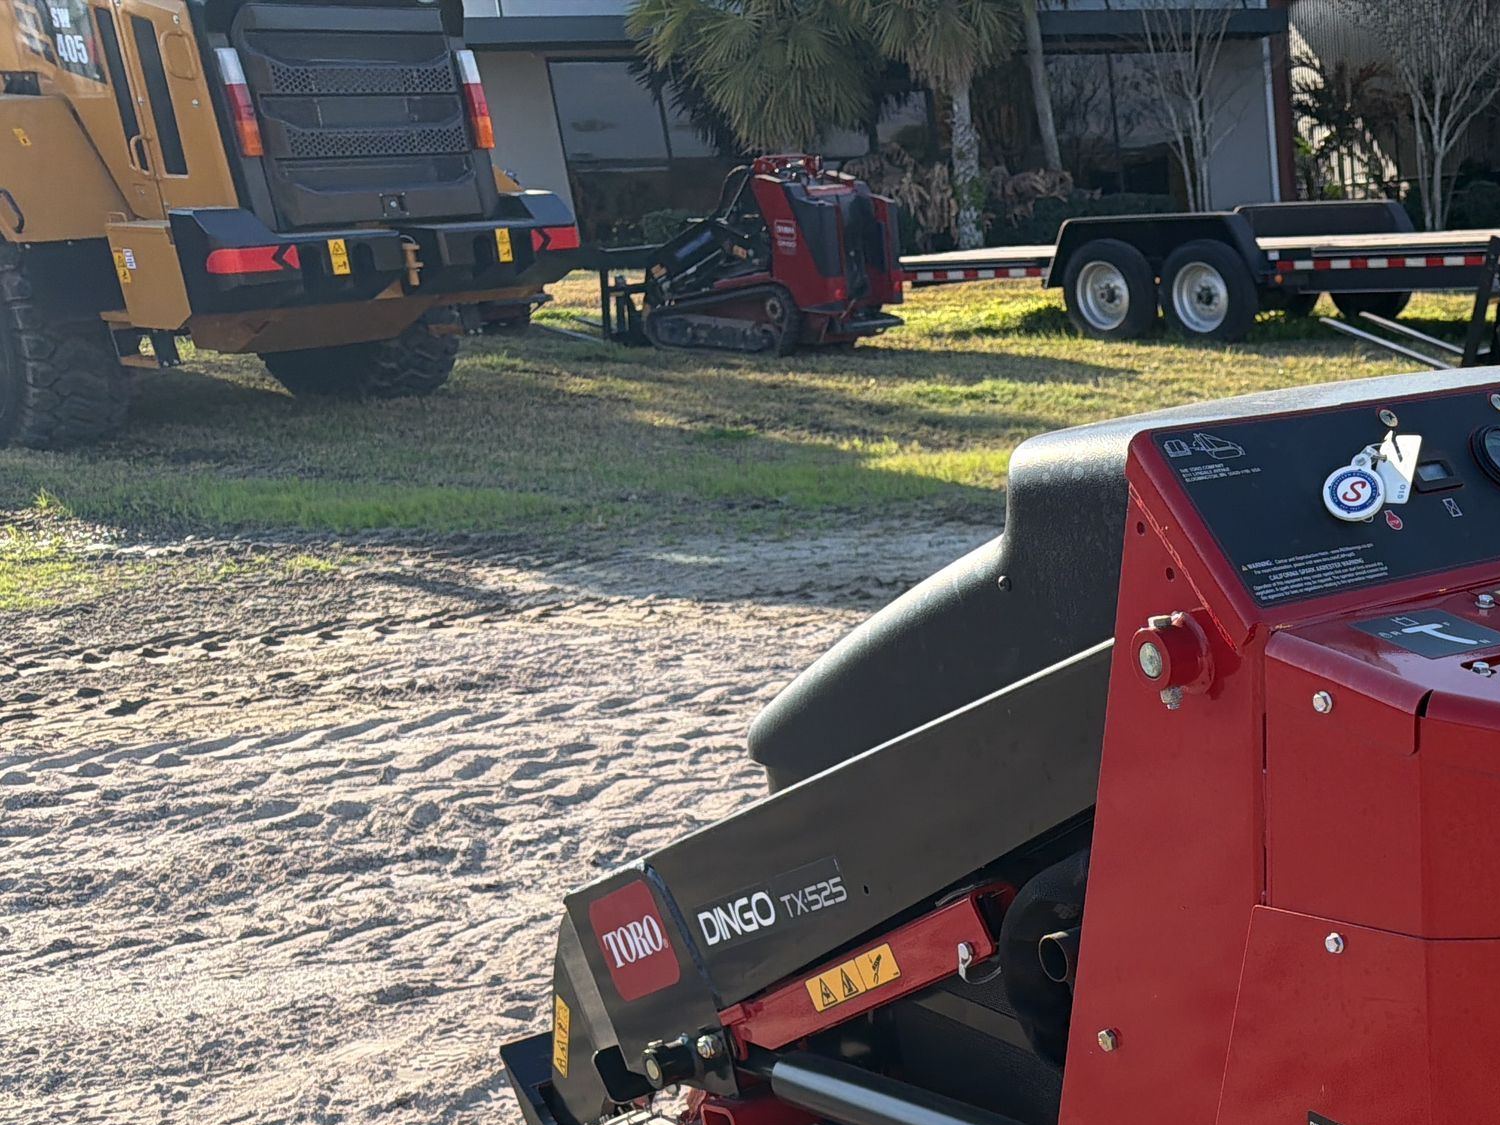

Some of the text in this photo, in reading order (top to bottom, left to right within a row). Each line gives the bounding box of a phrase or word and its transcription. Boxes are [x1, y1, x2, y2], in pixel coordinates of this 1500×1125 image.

[56, 33, 88, 64] 405
[602, 914, 664, 969] TORO
[698, 891, 776, 946] DINGO
